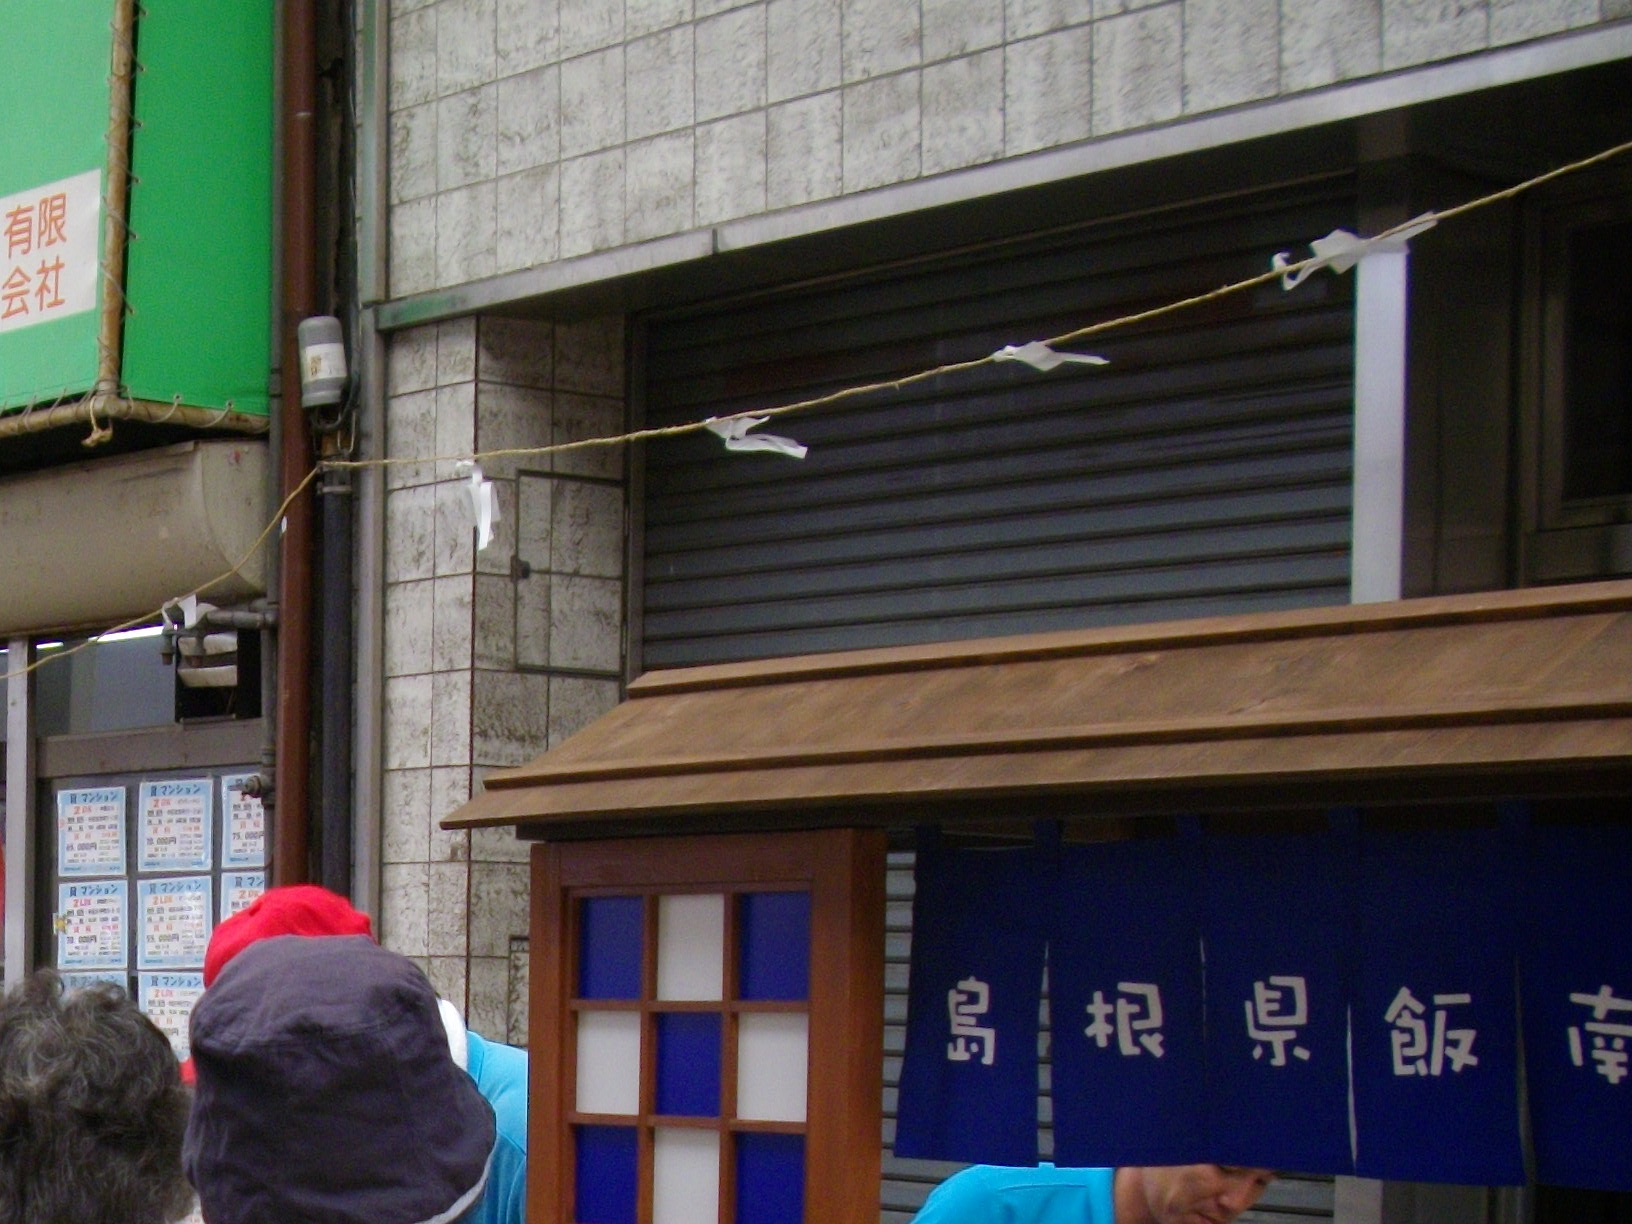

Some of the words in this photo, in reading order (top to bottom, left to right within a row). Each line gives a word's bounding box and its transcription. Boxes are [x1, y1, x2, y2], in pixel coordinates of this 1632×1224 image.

[3, 193, 67, 259] 有限
[0, 255, 66, 320] 会社
[947, 976, 1632, 1085] 島根県飯南
